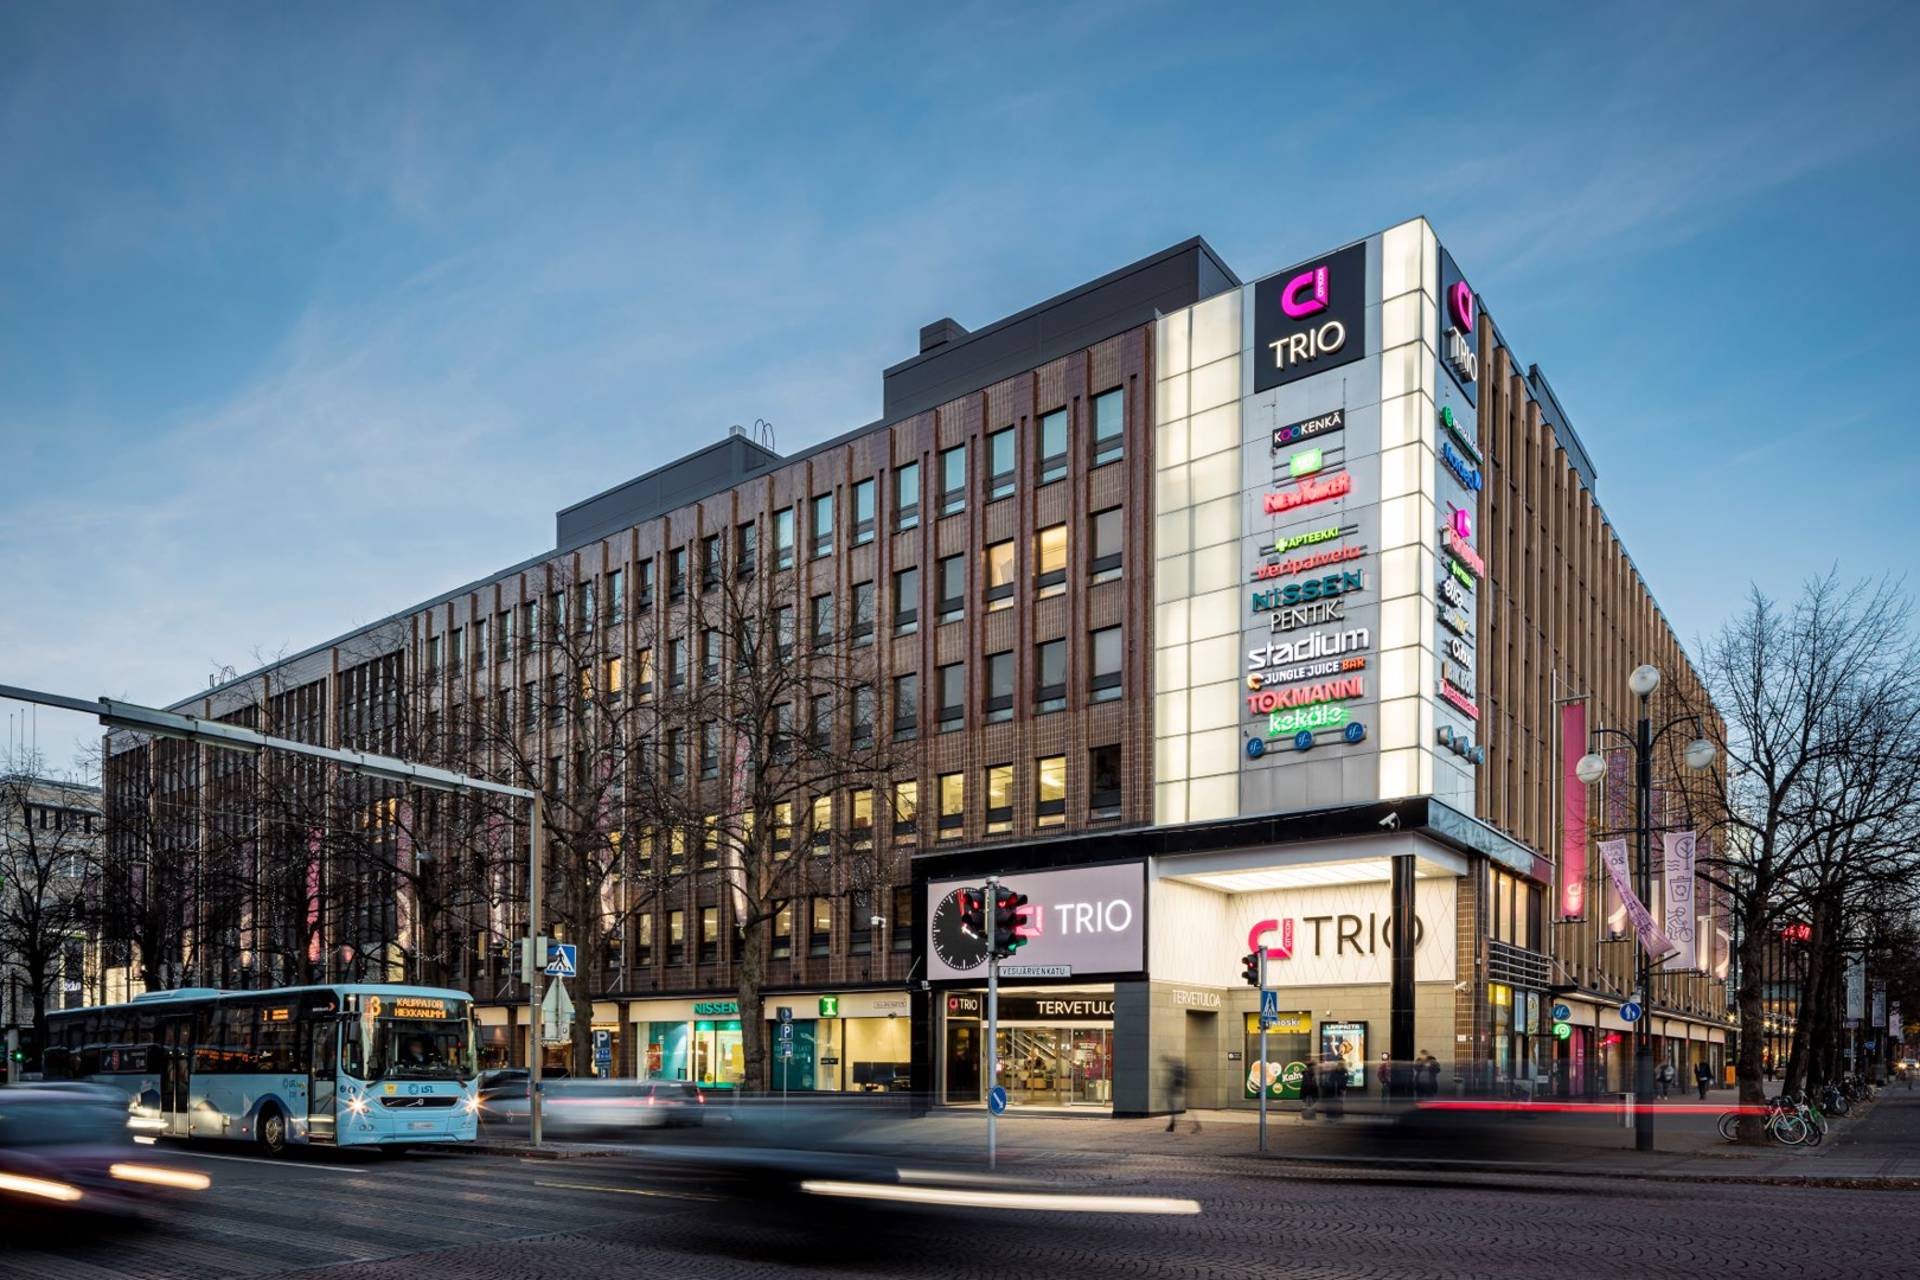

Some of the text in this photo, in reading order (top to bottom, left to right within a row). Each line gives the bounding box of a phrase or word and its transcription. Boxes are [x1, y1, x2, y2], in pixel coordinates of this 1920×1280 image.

[1268, 321, 1346, 368] TRIO
[1448, 326, 1478, 382] TRIO
[1274, 412, 1341, 442] KOOKENKÄ
[1288, 527, 1339, 547] APTEEKKI
[1252, 569, 1364, 612] NISSEN
[1248, 627, 1369, 670] stadium
[1265, 656, 1366, 684] JUNGLE JUICE BAR
[1248, 676, 1363, 714] TOKMANNI
[1270, 705, 1343, 732] kekäle
[1054, 899, 1132, 935] TRIO
[1303, 913, 1424, 955] TRIO
[694, 1001, 738, 1015] NISSEN
[960, 998, 978, 1011] TRIO
[1172, 989, 1222, 1008] TERVETULOA
